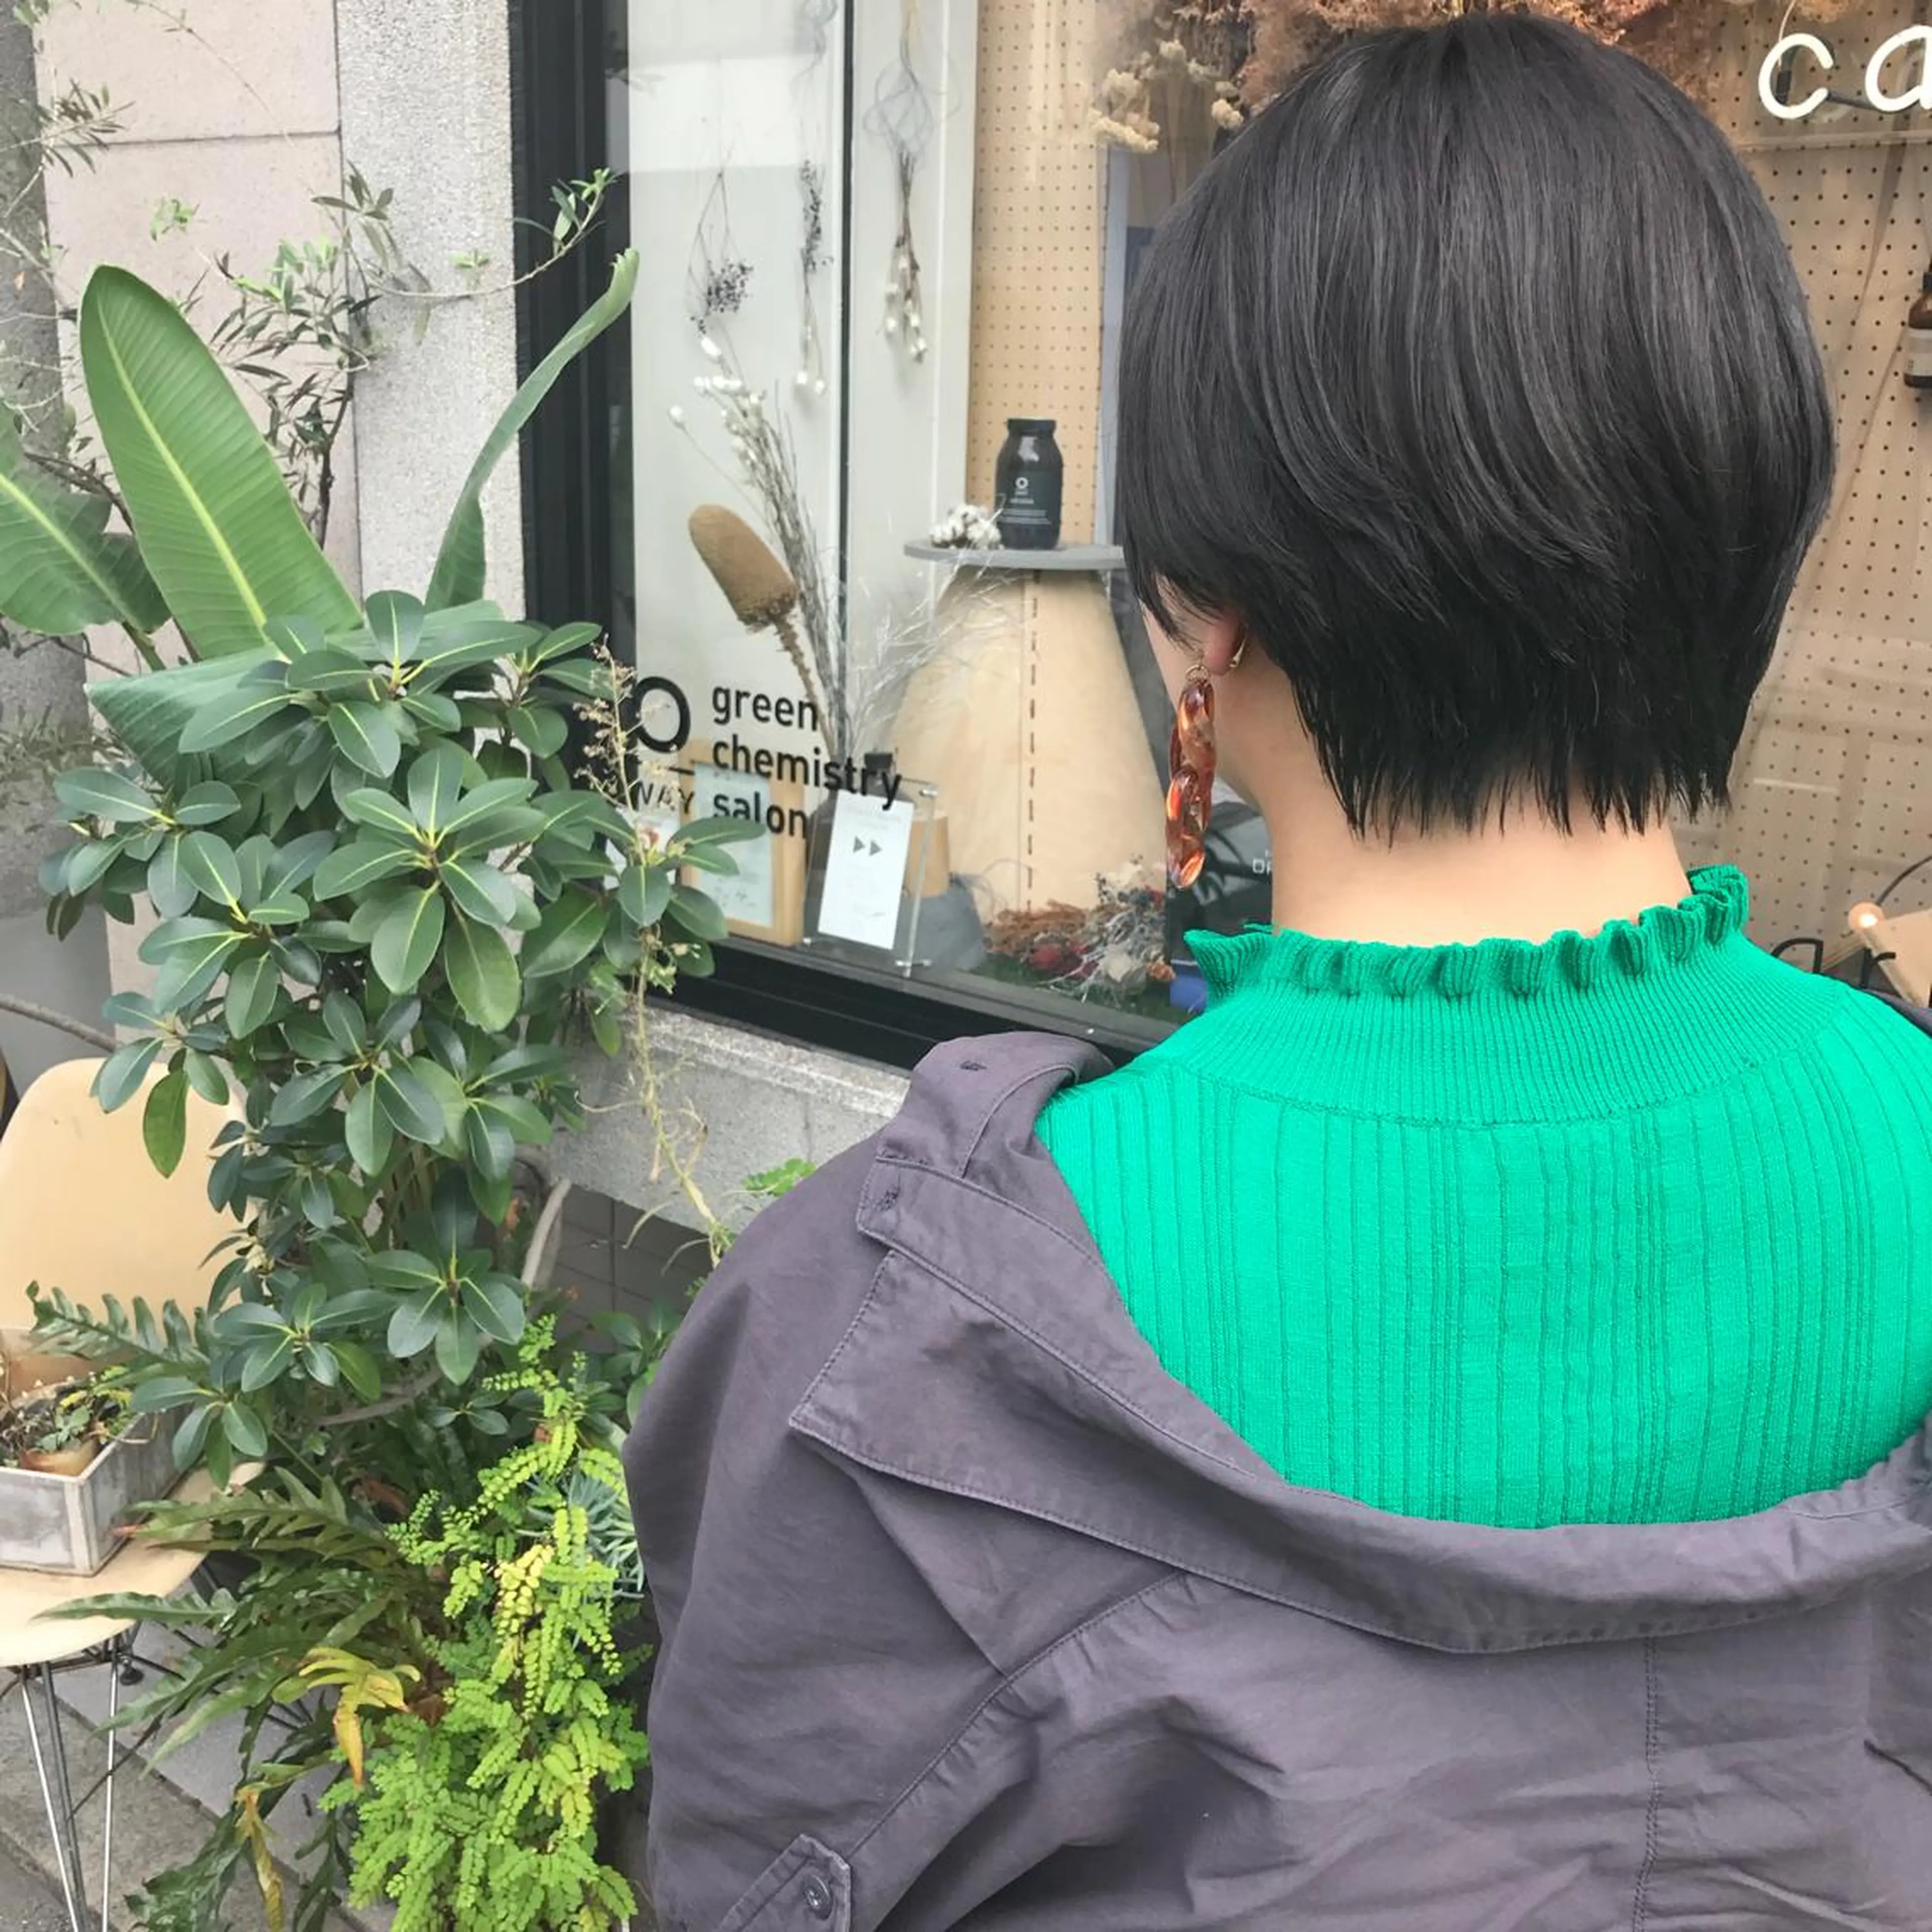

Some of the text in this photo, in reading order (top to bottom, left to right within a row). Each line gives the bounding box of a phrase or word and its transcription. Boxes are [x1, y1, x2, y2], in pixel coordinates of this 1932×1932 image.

[712, 685, 819, 731] green
[712, 733, 902, 811] chemistry
[713, 791, 808, 839] salon
